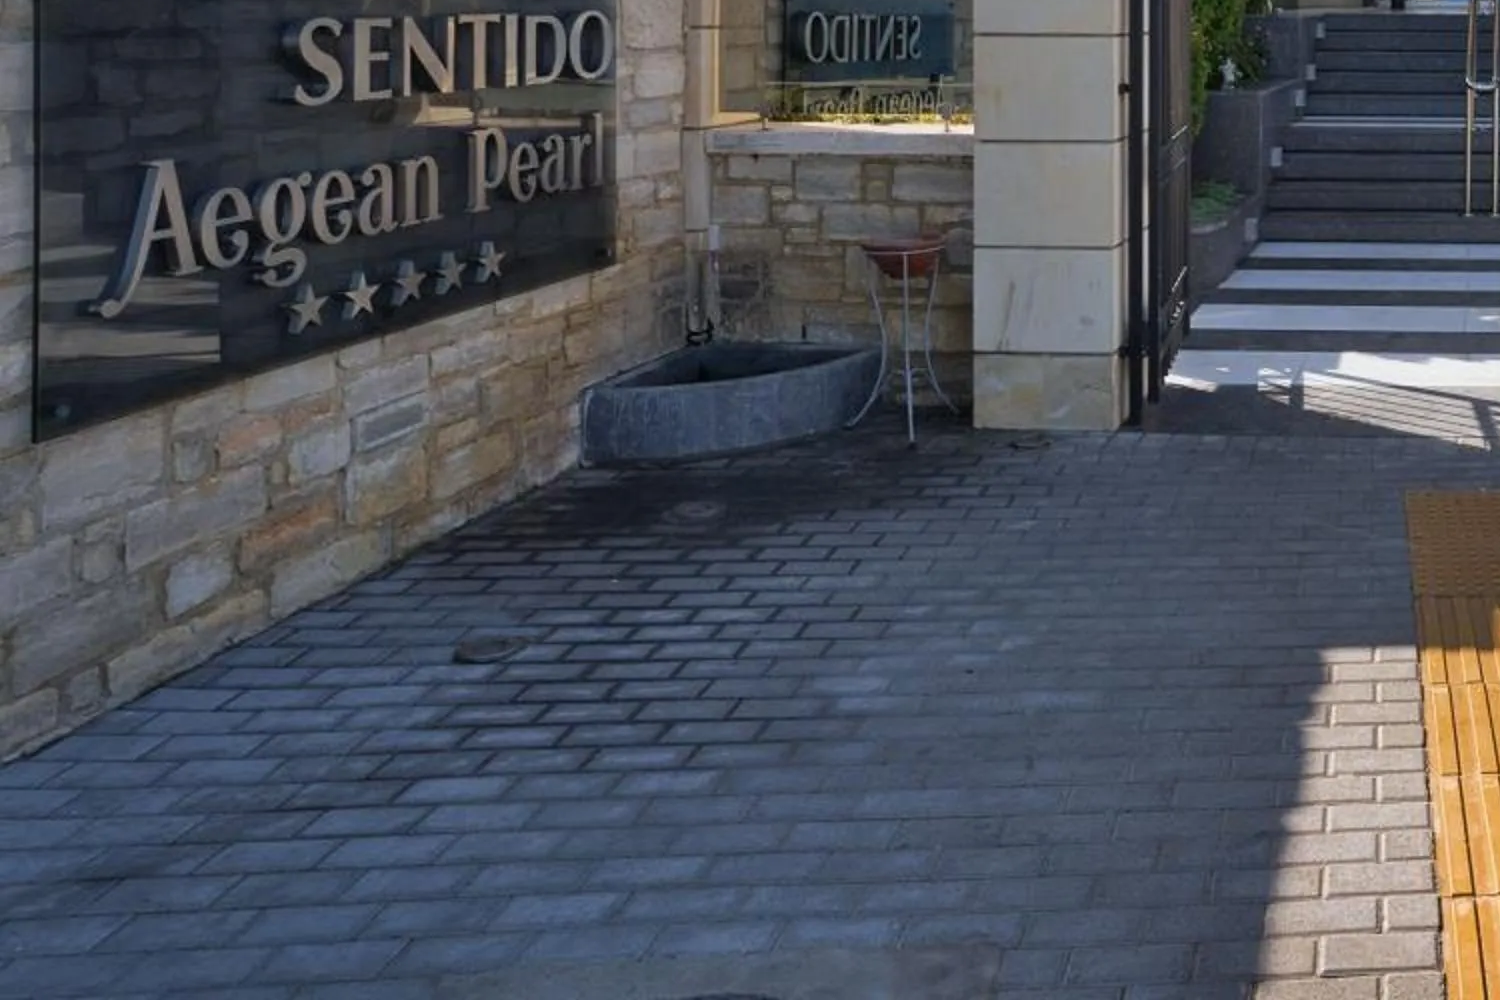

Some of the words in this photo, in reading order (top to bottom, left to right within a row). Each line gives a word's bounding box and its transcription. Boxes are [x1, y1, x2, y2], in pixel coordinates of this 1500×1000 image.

[294, 10, 612, 106] SENTIDO
[88, 153, 444, 318] Aegean
[464, 112, 606, 213] Pearl
